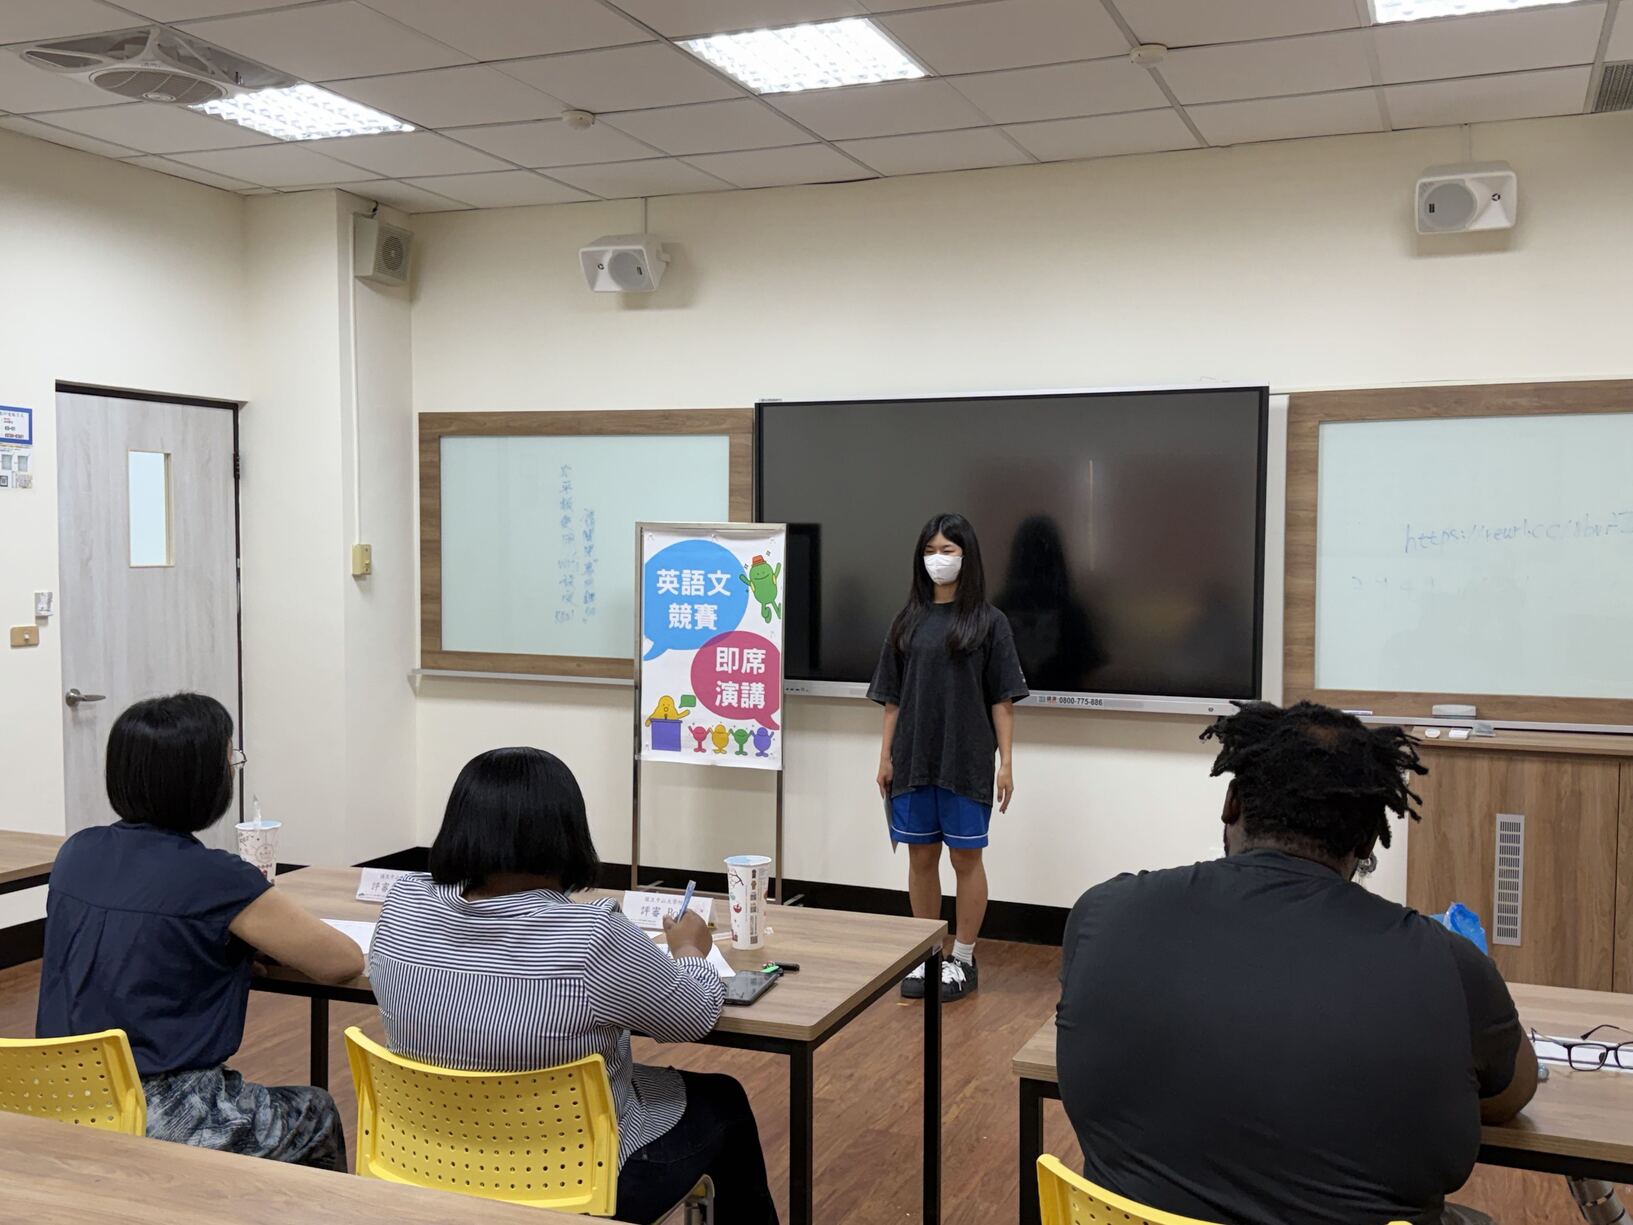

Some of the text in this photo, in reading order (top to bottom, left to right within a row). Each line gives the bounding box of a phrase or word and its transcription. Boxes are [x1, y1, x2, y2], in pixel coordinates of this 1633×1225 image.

[656, 569, 731, 597] 英語文
[668, 602, 718, 631] 競賽
[715, 647, 766, 675] 即席
[715, 680, 766, 709] 演講
